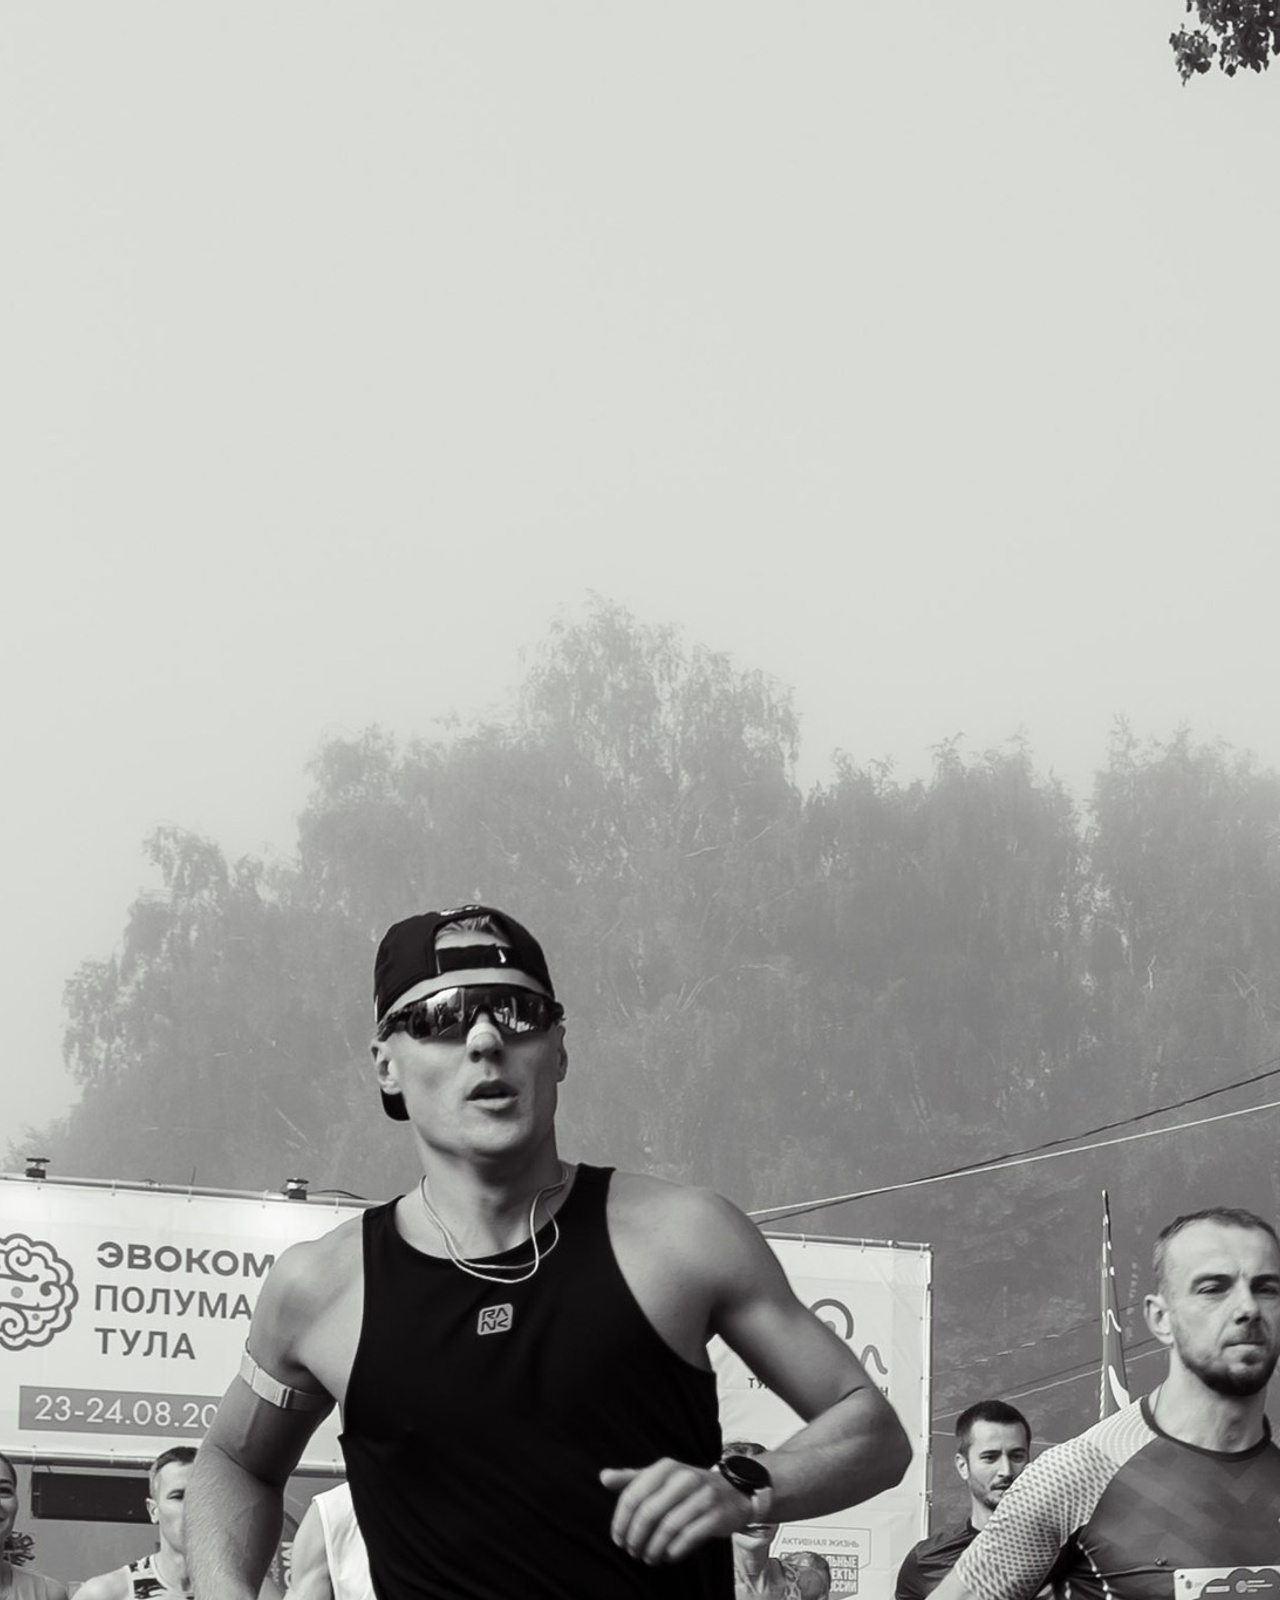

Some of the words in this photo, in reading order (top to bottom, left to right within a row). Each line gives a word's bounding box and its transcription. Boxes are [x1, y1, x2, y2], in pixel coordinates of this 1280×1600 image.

[97, 1241, 275, 1278] ЭВОКОМ
[95, 1284, 252, 1321] ПОЛУМА
[95, 1327, 196, 1360] ТУЛА
